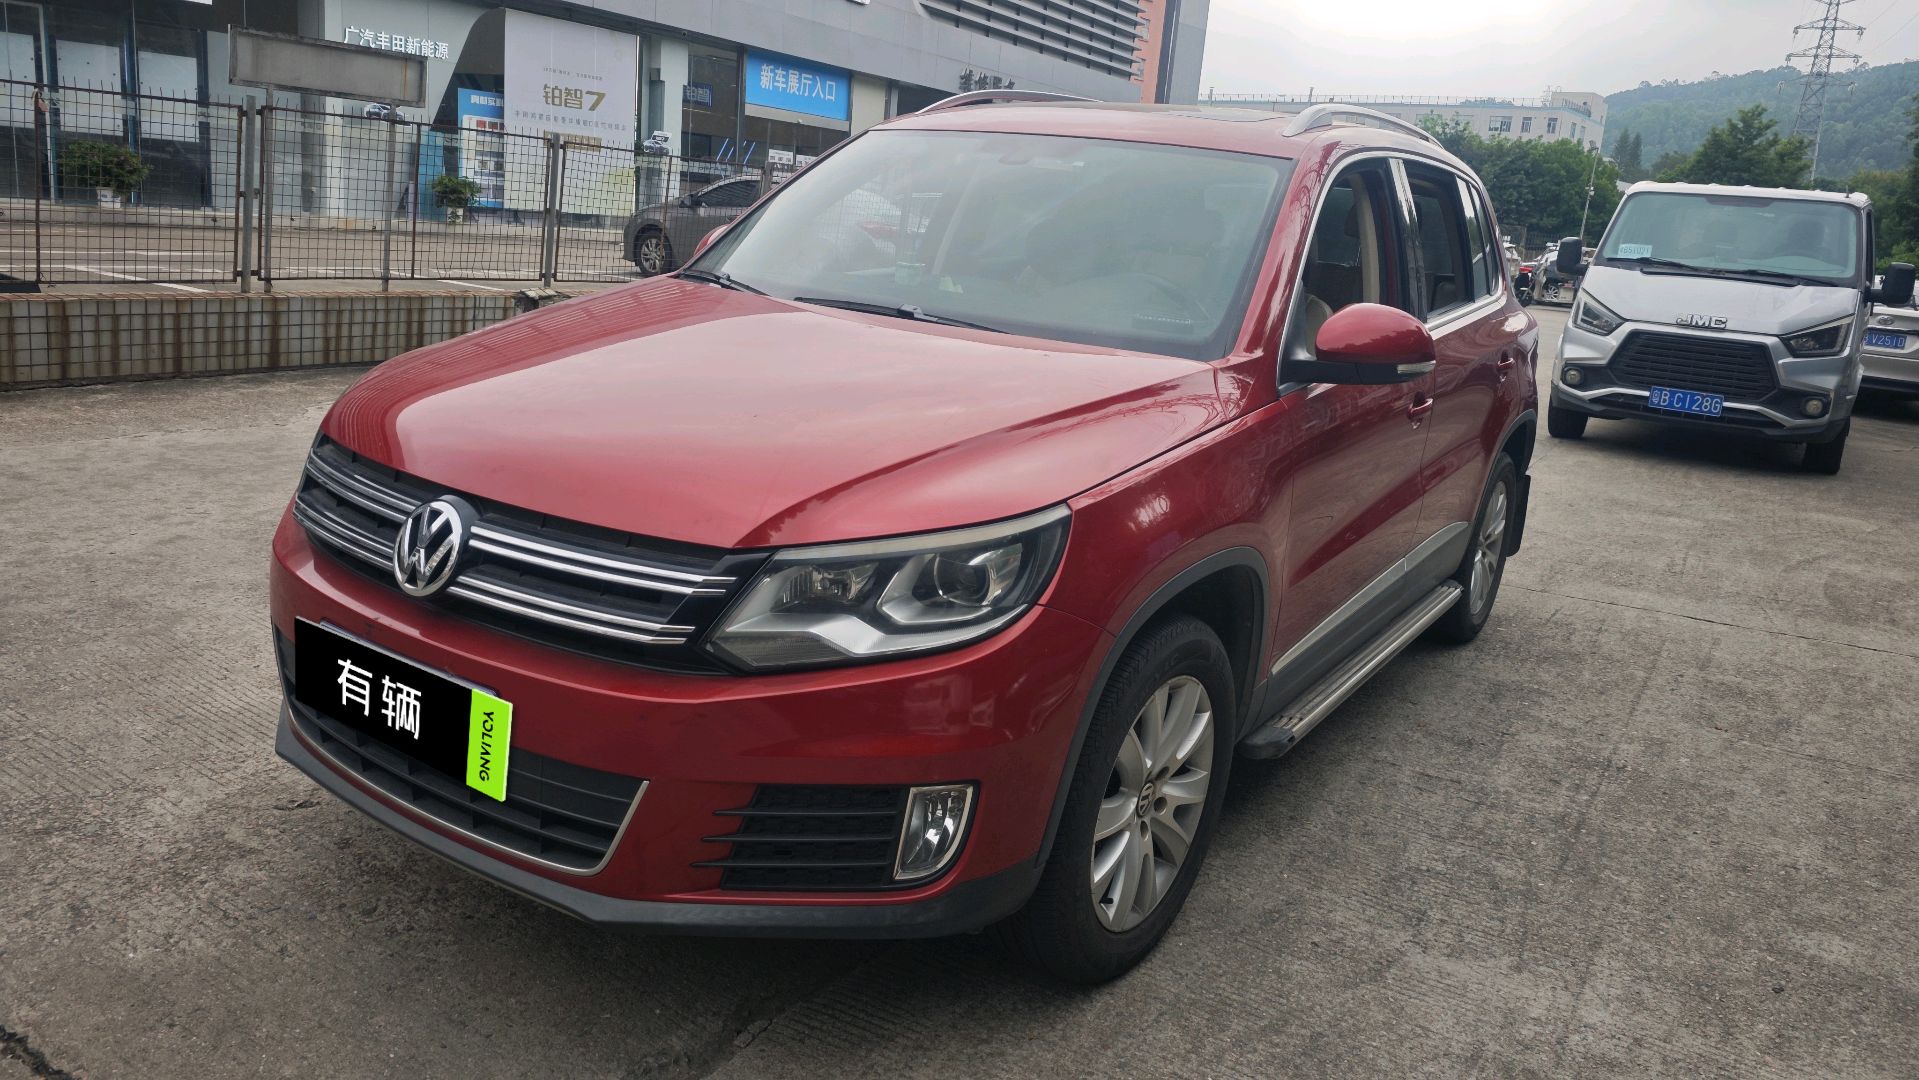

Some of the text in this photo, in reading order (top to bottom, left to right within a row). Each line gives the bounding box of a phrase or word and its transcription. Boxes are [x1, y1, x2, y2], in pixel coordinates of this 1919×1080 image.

[343, 26, 449, 60] 广汽丰田新能源
[543, 83, 606, 112] 铂智7
[760, 63, 836, 102] 新车展厅入口
[1676, 314, 1728, 329] JMC
